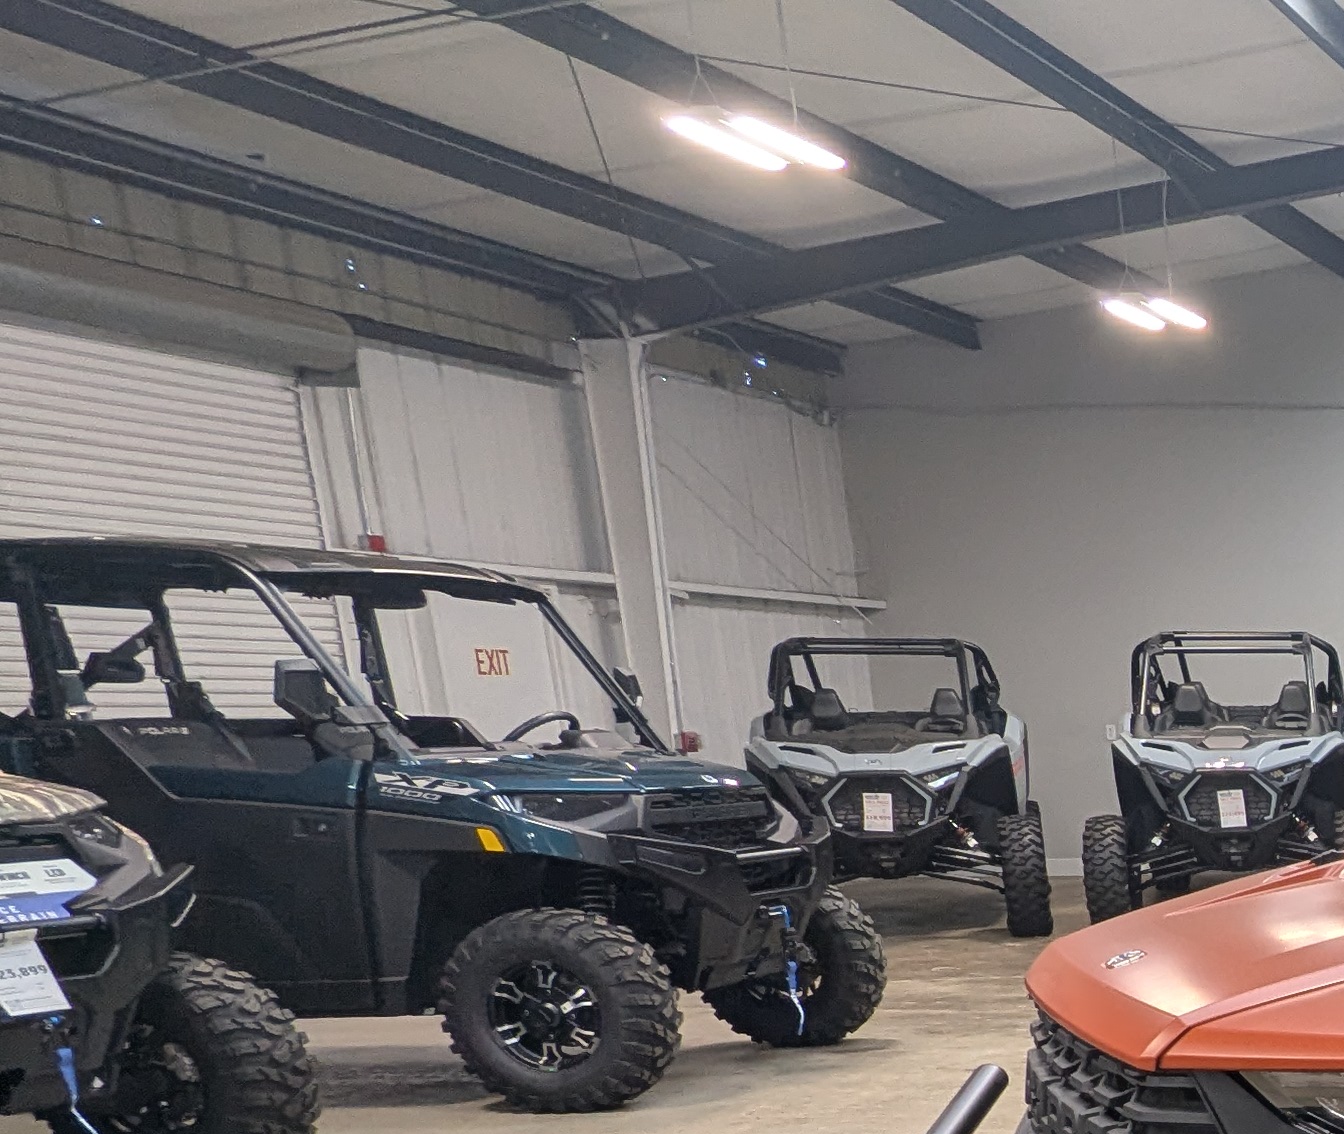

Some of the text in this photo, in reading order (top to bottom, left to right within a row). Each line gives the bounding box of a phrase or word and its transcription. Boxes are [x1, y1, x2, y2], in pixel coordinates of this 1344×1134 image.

[474, 648, 509, 676] EXIT
[382, 770, 471, 791] XP
[379, 785, 443, 802] 1000
